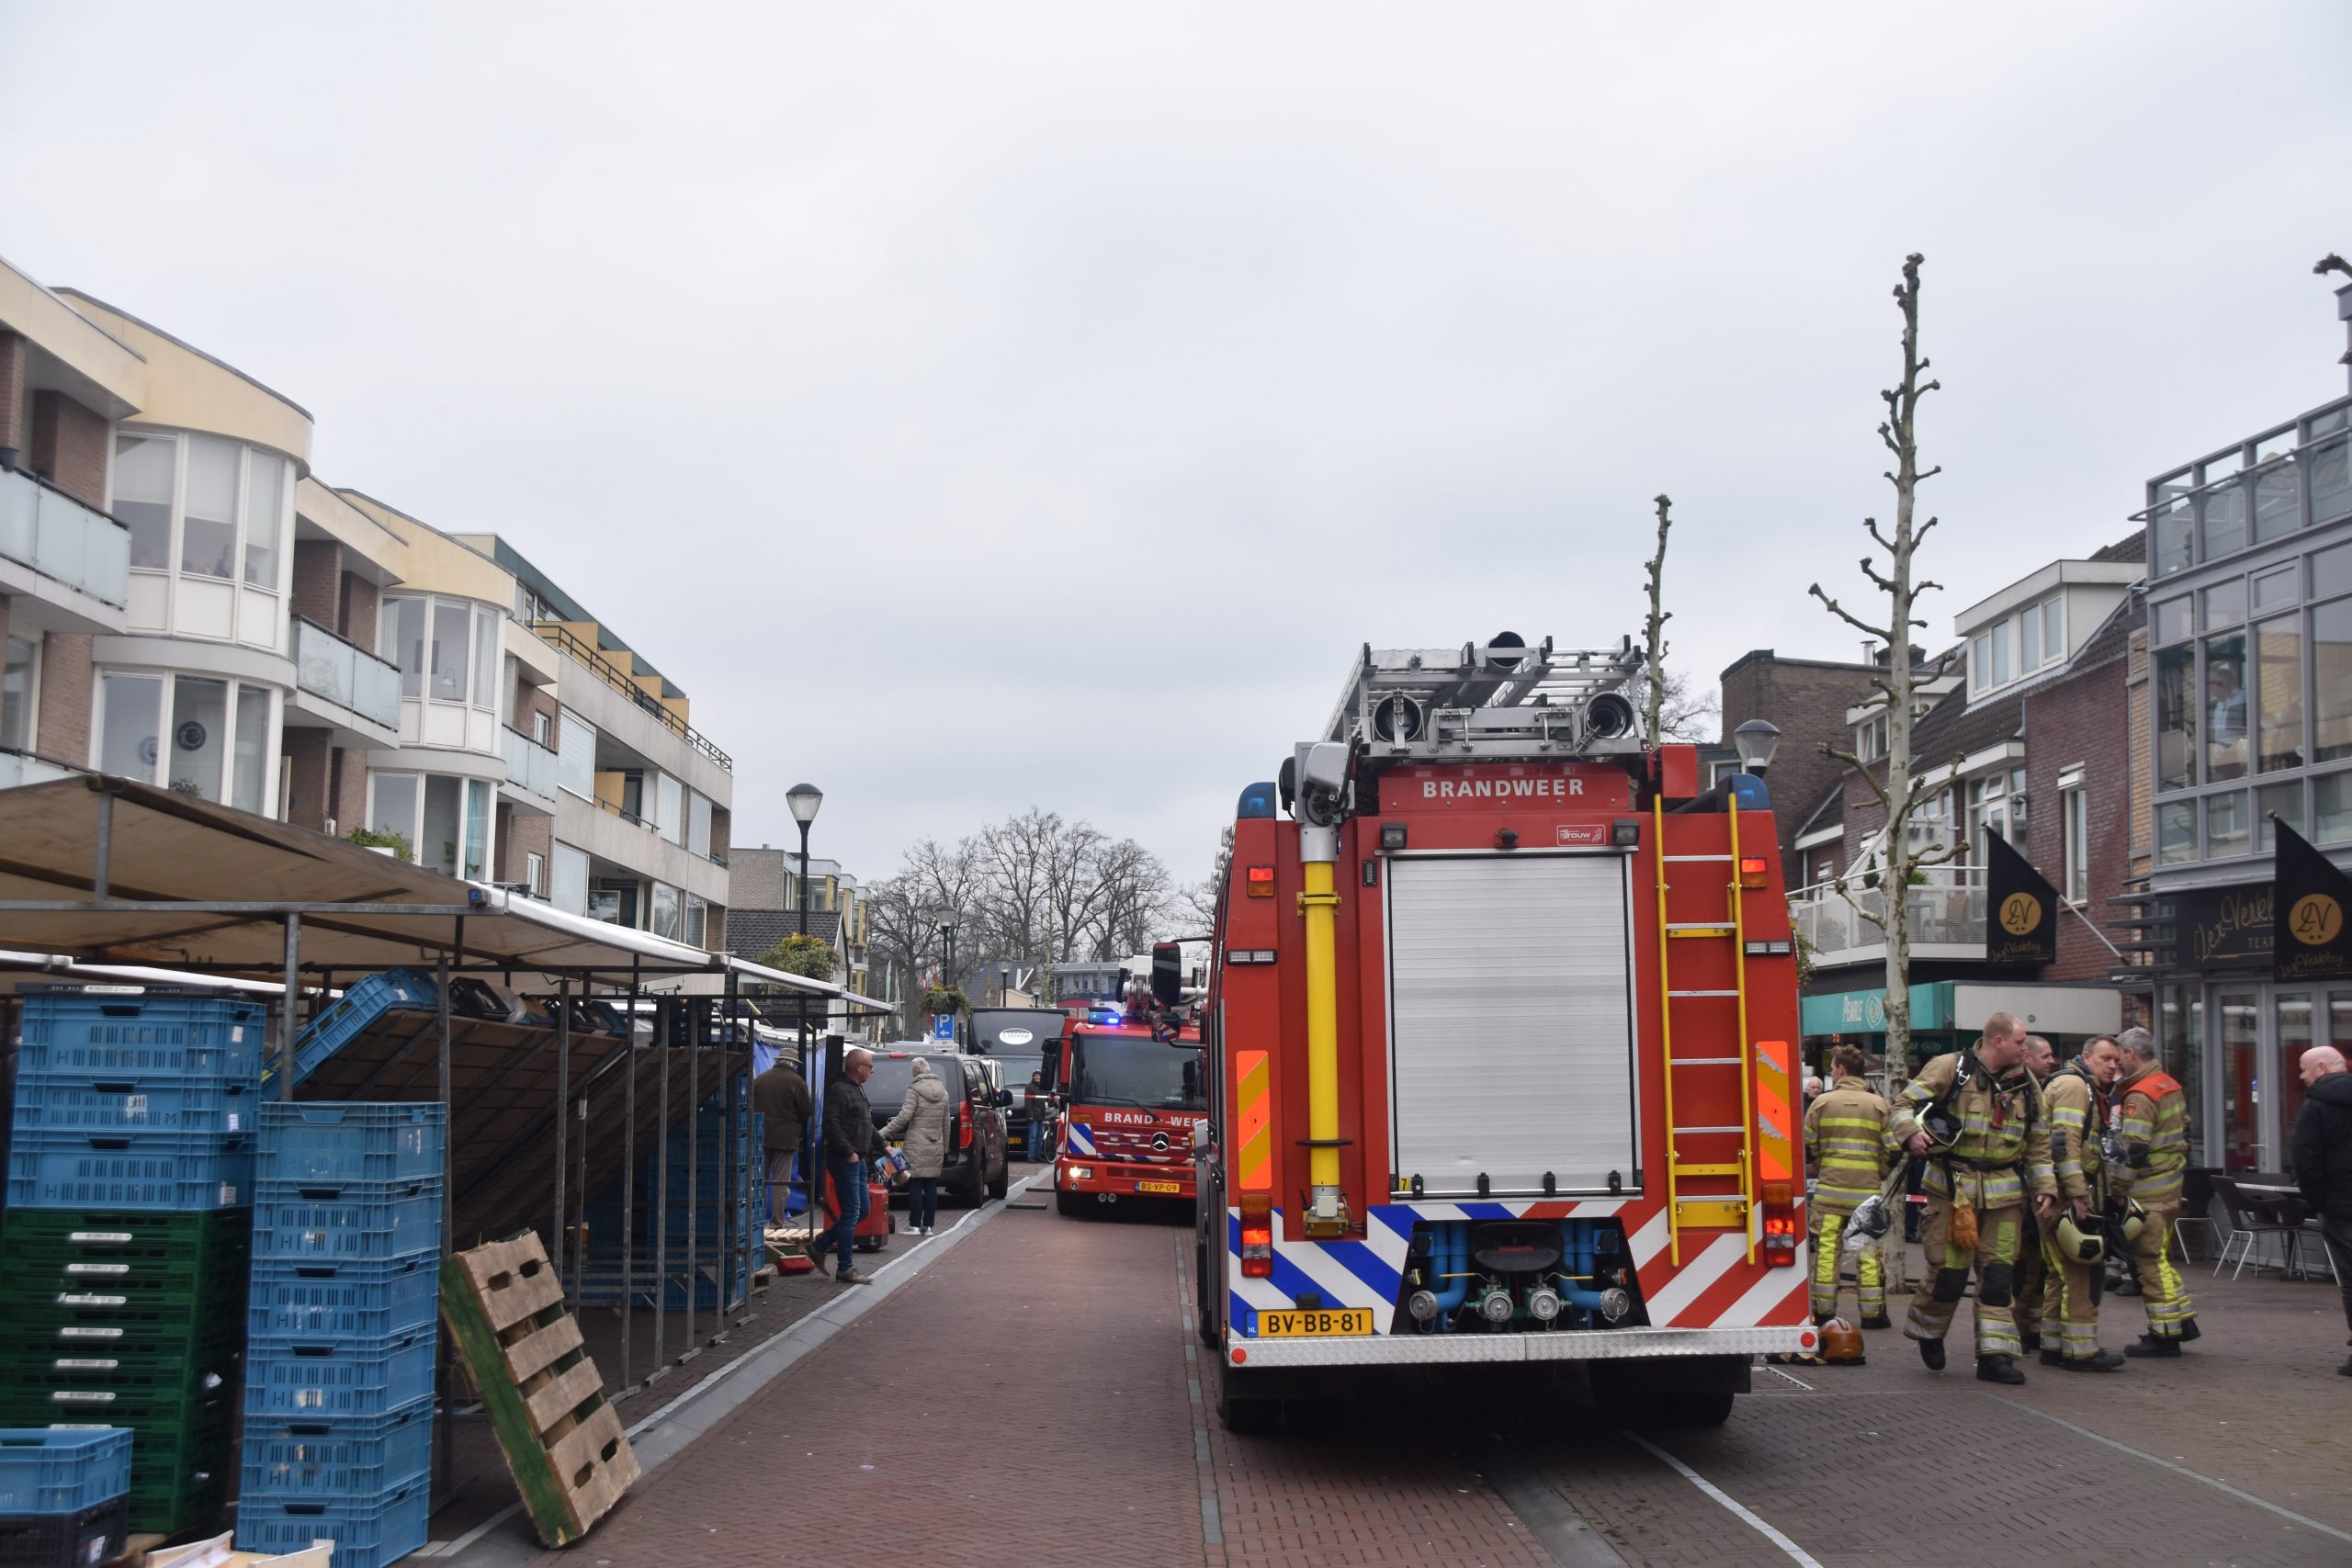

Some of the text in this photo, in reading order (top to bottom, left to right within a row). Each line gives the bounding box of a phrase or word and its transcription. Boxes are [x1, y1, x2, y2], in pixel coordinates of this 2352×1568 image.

[1423, 779, 1584, 798] BRANDWEER
[939, 1014, 950, 1028] P
[1104, 1112, 1153, 1124] BRAND
[1141, 1182, 1178, 1191] BS-VP-09
[1401, 1178, 1408, 1191] 7
[1268, 1313, 1363, 1334] BV-BB-81
